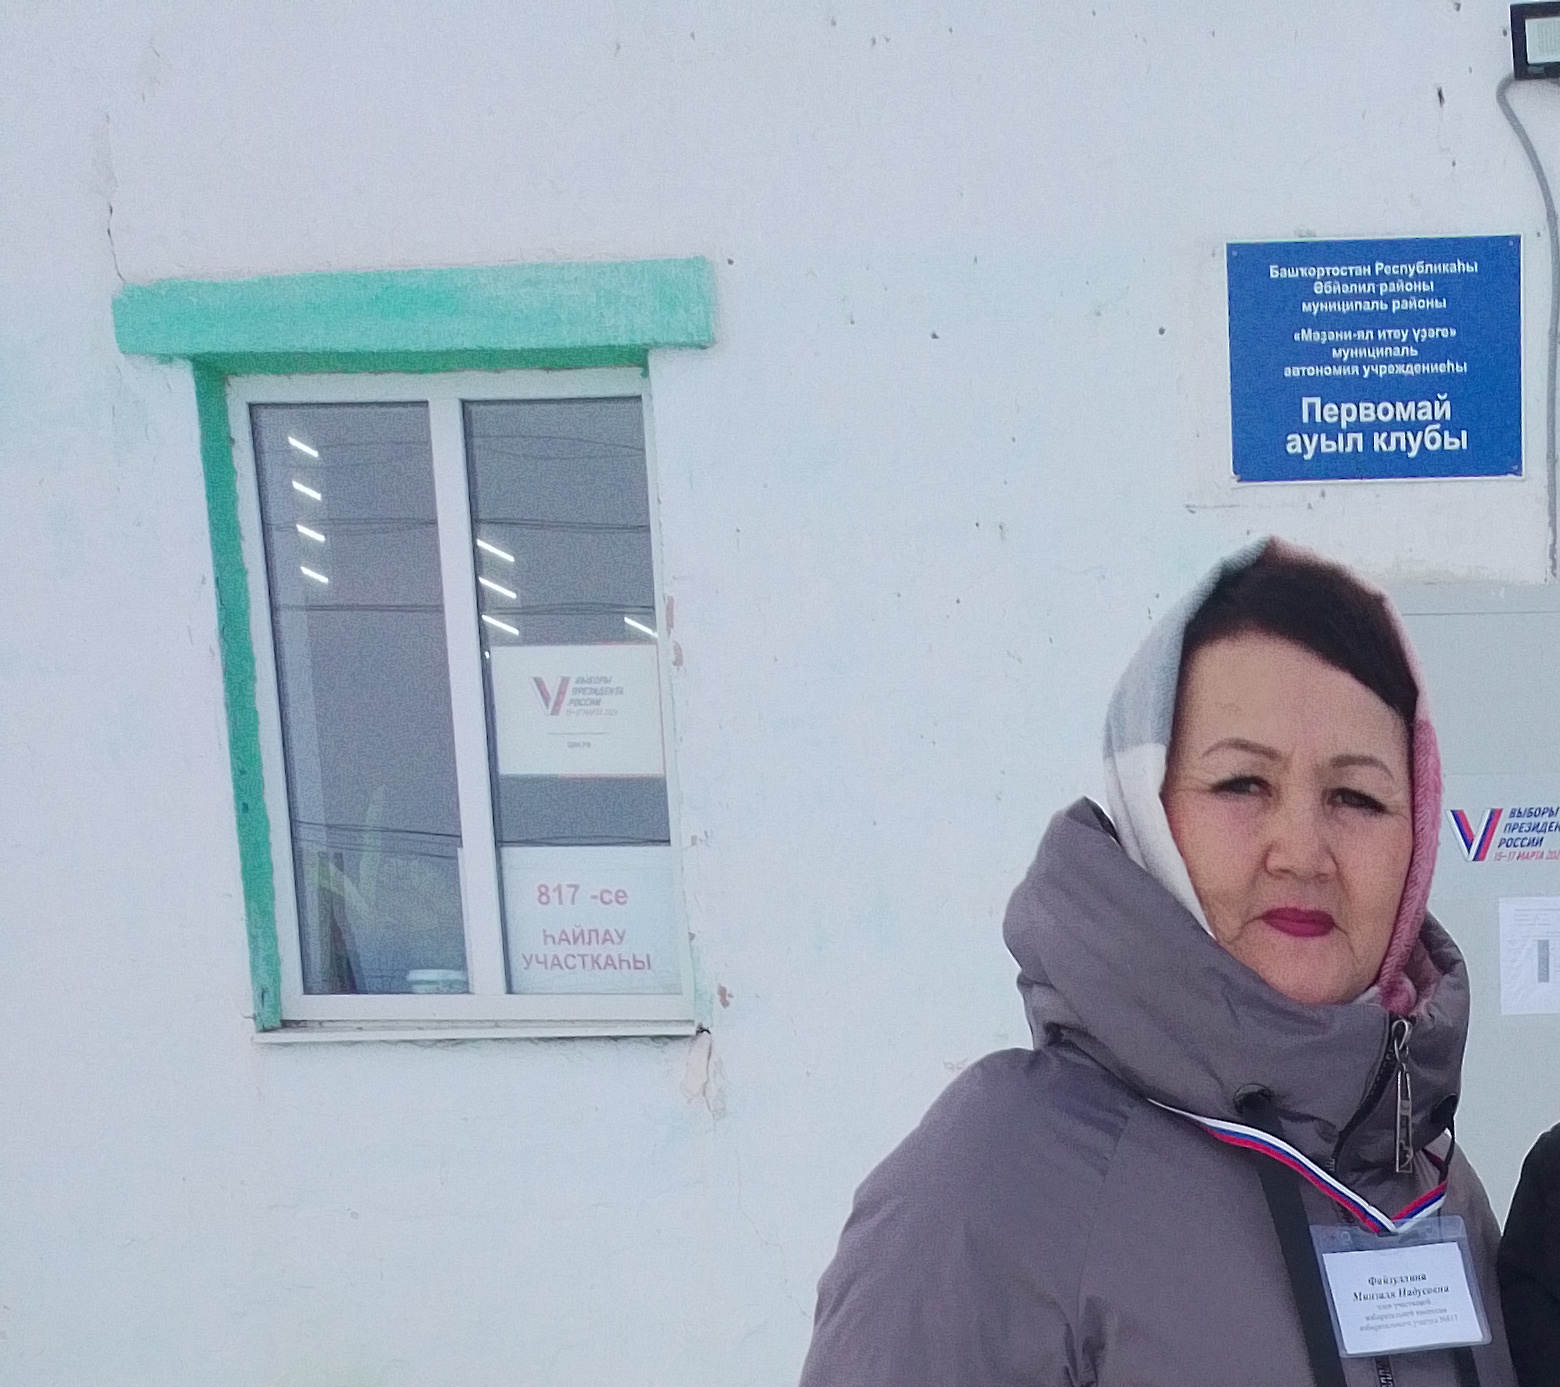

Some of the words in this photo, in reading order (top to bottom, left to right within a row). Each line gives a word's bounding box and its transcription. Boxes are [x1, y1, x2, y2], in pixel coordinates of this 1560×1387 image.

[1379, 279, 1434, 297] районы
[1302, 299, 1388, 316] муниципаль
[1392, 296, 1447, 314] районы
[1332, 346, 1418, 362] муниципаль
[1284, 365, 1359, 378] автономия
[1302, 392, 1451, 429] Первомай
[1286, 432, 1363, 460] ауыл
[1373, 423, 1468, 458] клубы
[1508, 806, 1560, 819] ВЫБОРЫ
[1498, 836, 1544, 849] РОССИИ
[1517, 850, 1544, 860] МАРТА
[536, 884, 580, 905] 817
[590, 888, 628, 906] -се
